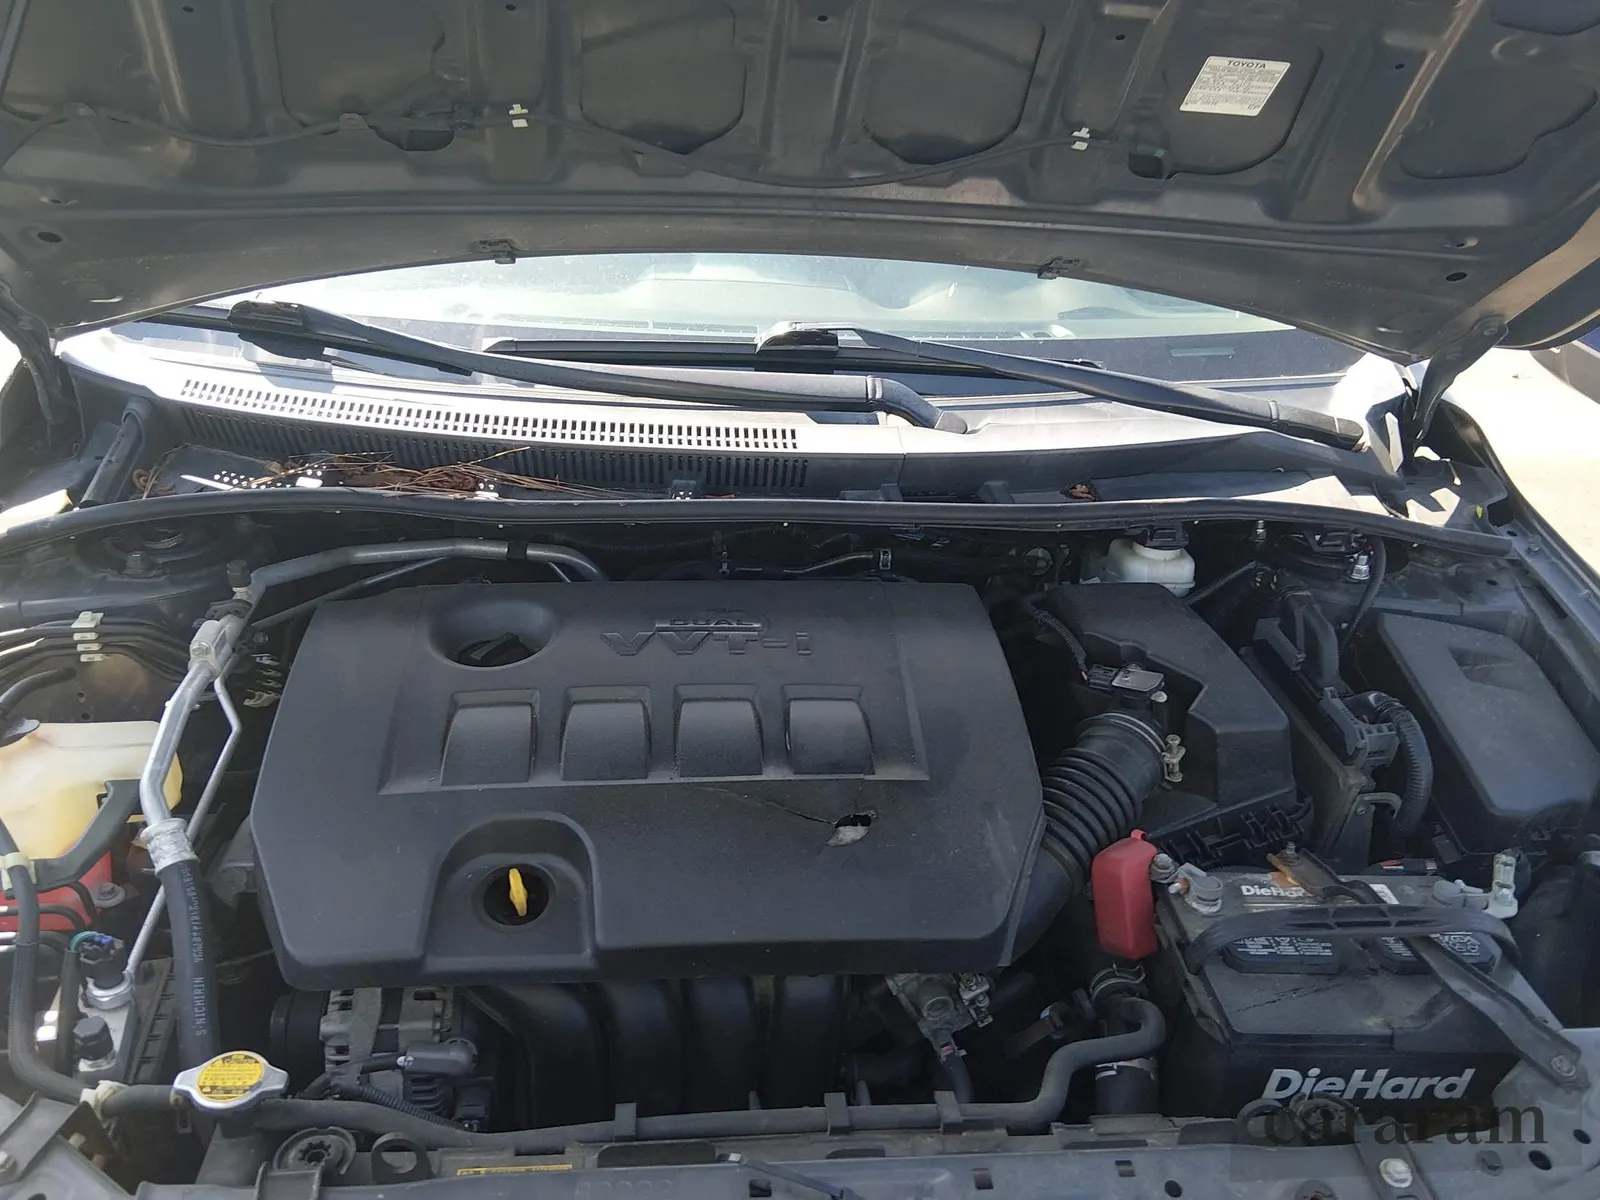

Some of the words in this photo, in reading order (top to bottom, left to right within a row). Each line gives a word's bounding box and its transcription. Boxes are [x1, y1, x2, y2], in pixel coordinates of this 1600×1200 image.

[1227, 60, 1267, 69] TOYOTA
[668, 618, 755, 626] DUAL
[1261, 1067, 1477, 1101] DieHard
